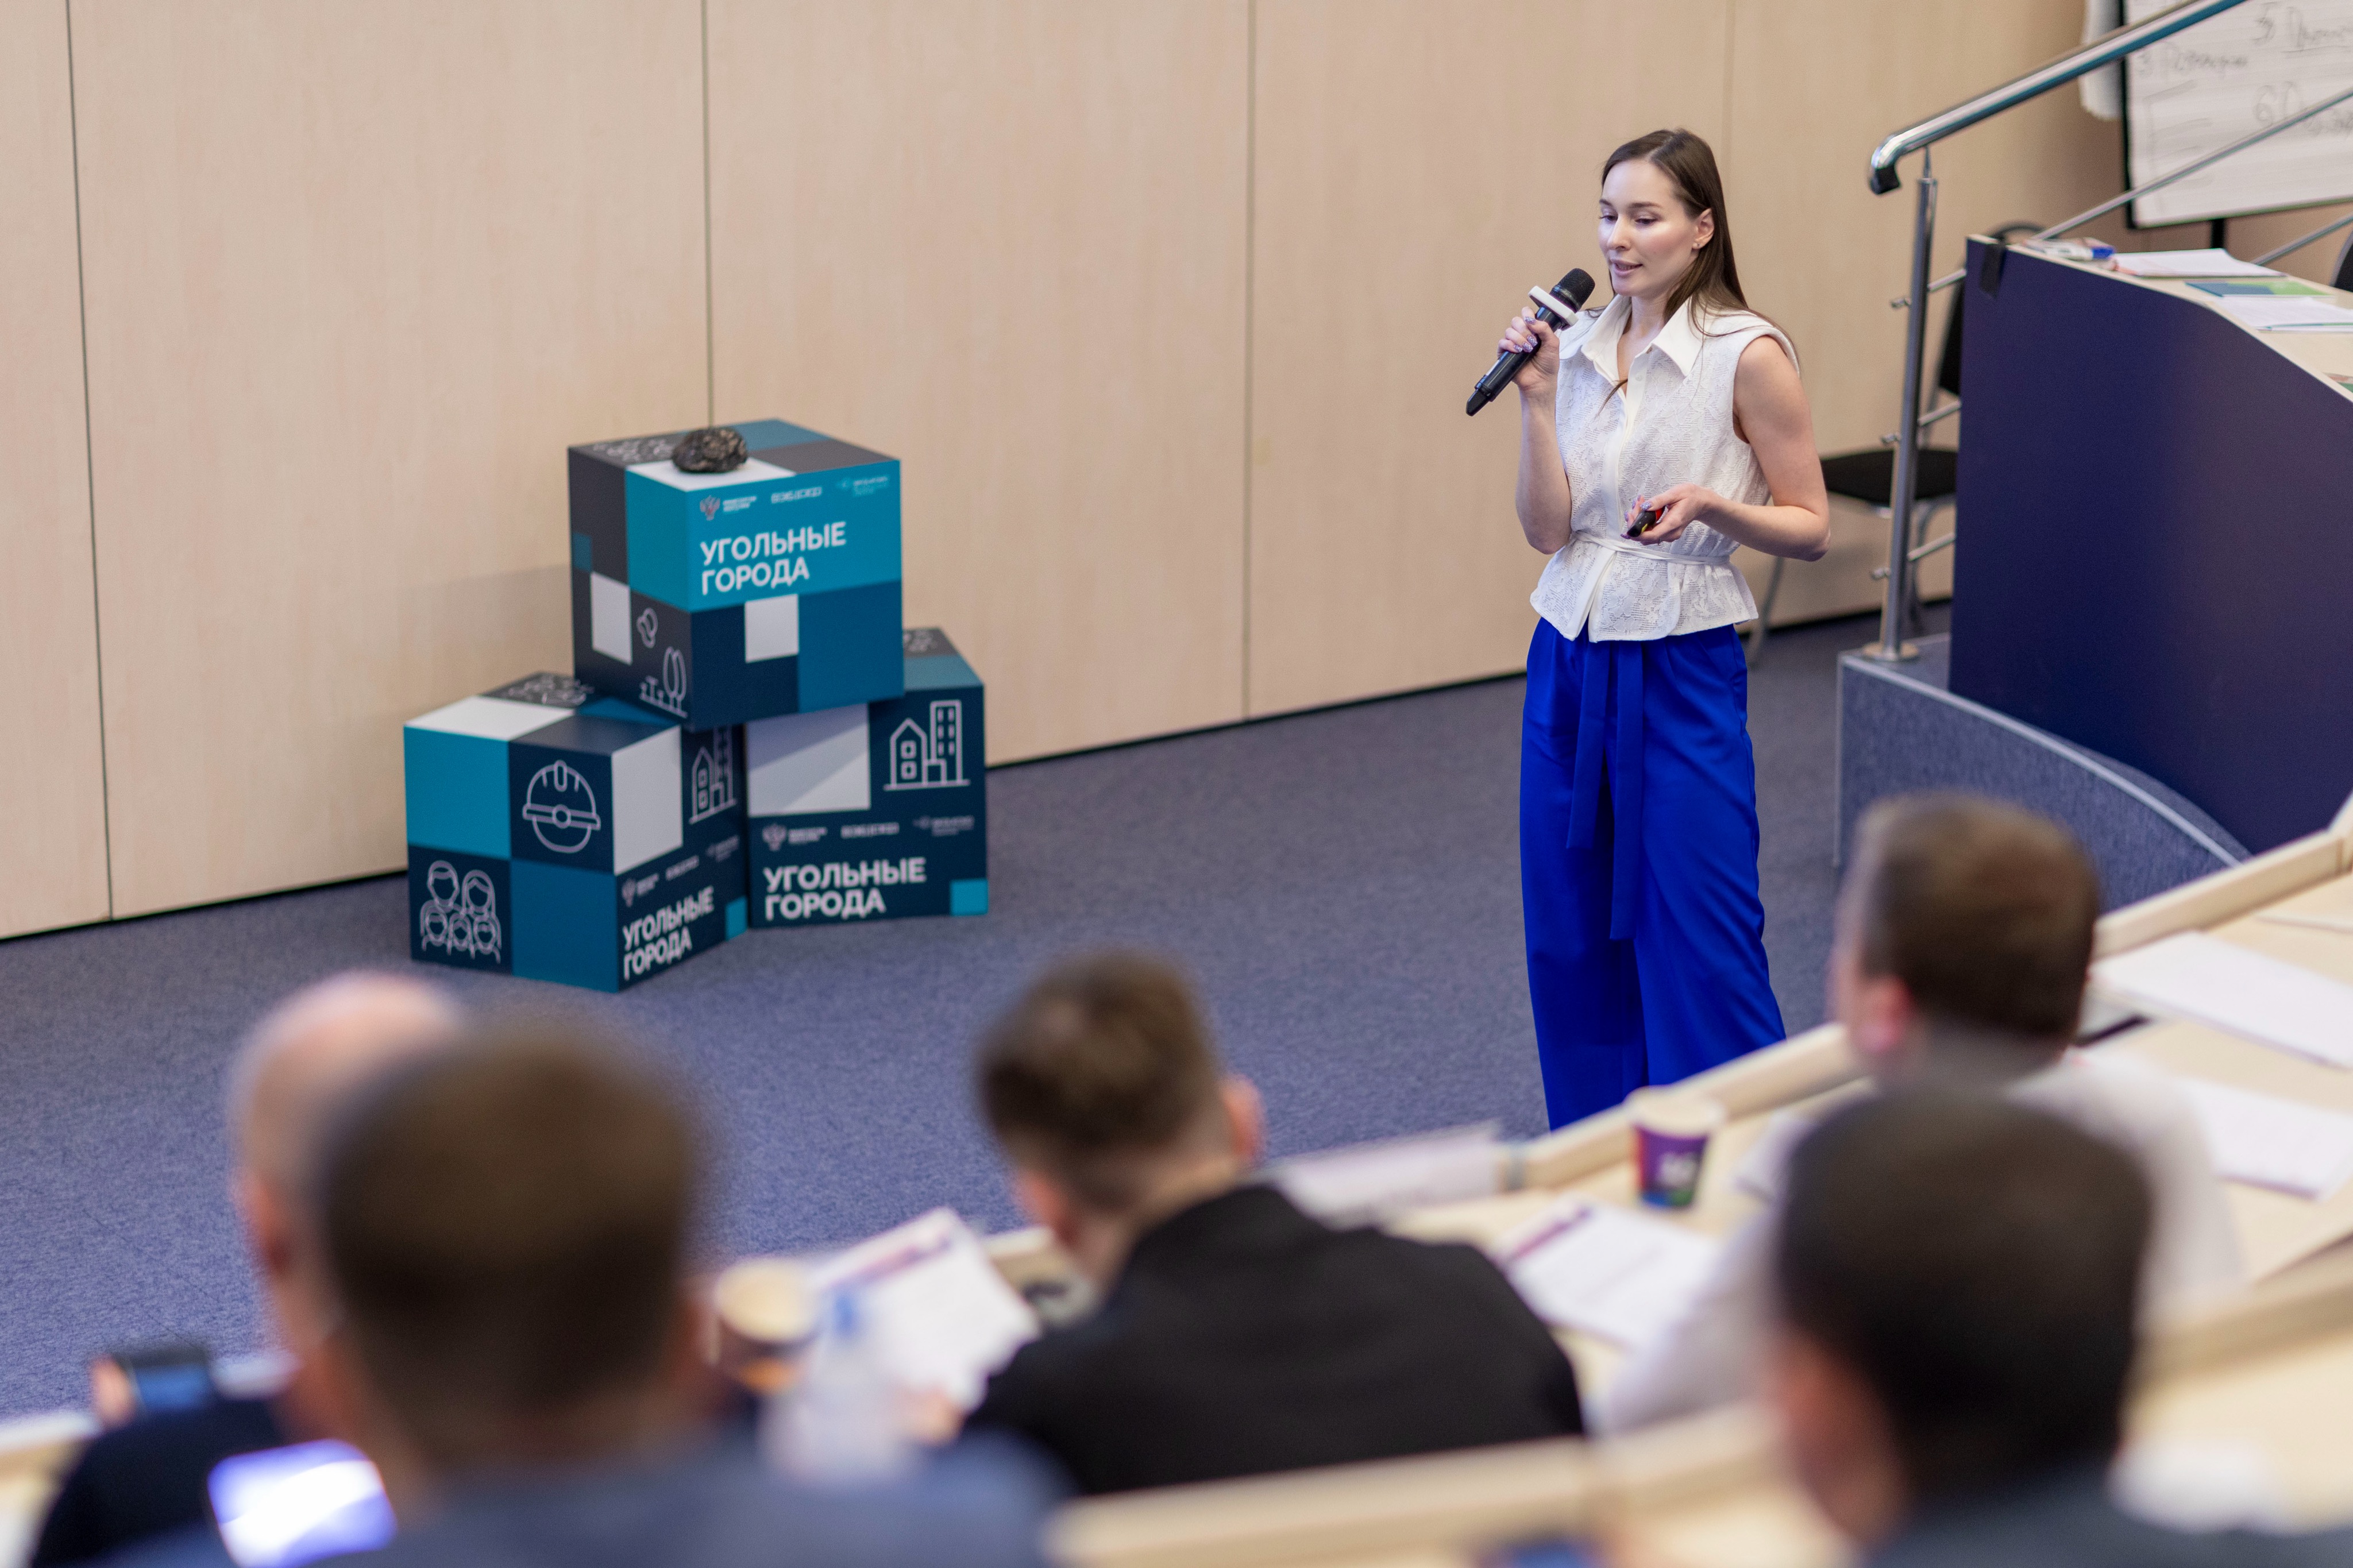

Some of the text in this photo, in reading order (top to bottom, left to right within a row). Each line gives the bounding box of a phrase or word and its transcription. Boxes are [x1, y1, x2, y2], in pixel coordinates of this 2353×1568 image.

[700, 522, 846, 566] УГОЛЬНЫЕ
[702, 557, 809, 596] ГОРОДА
[763, 858, 926, 893] УГОЛЬНЫЕ
[623, 886, 714, 951] УГОЛЬНЫЕ
[765, 889, 885, 920] ГОРОДА
[624, 926, 692, 980] ГОРОДА
